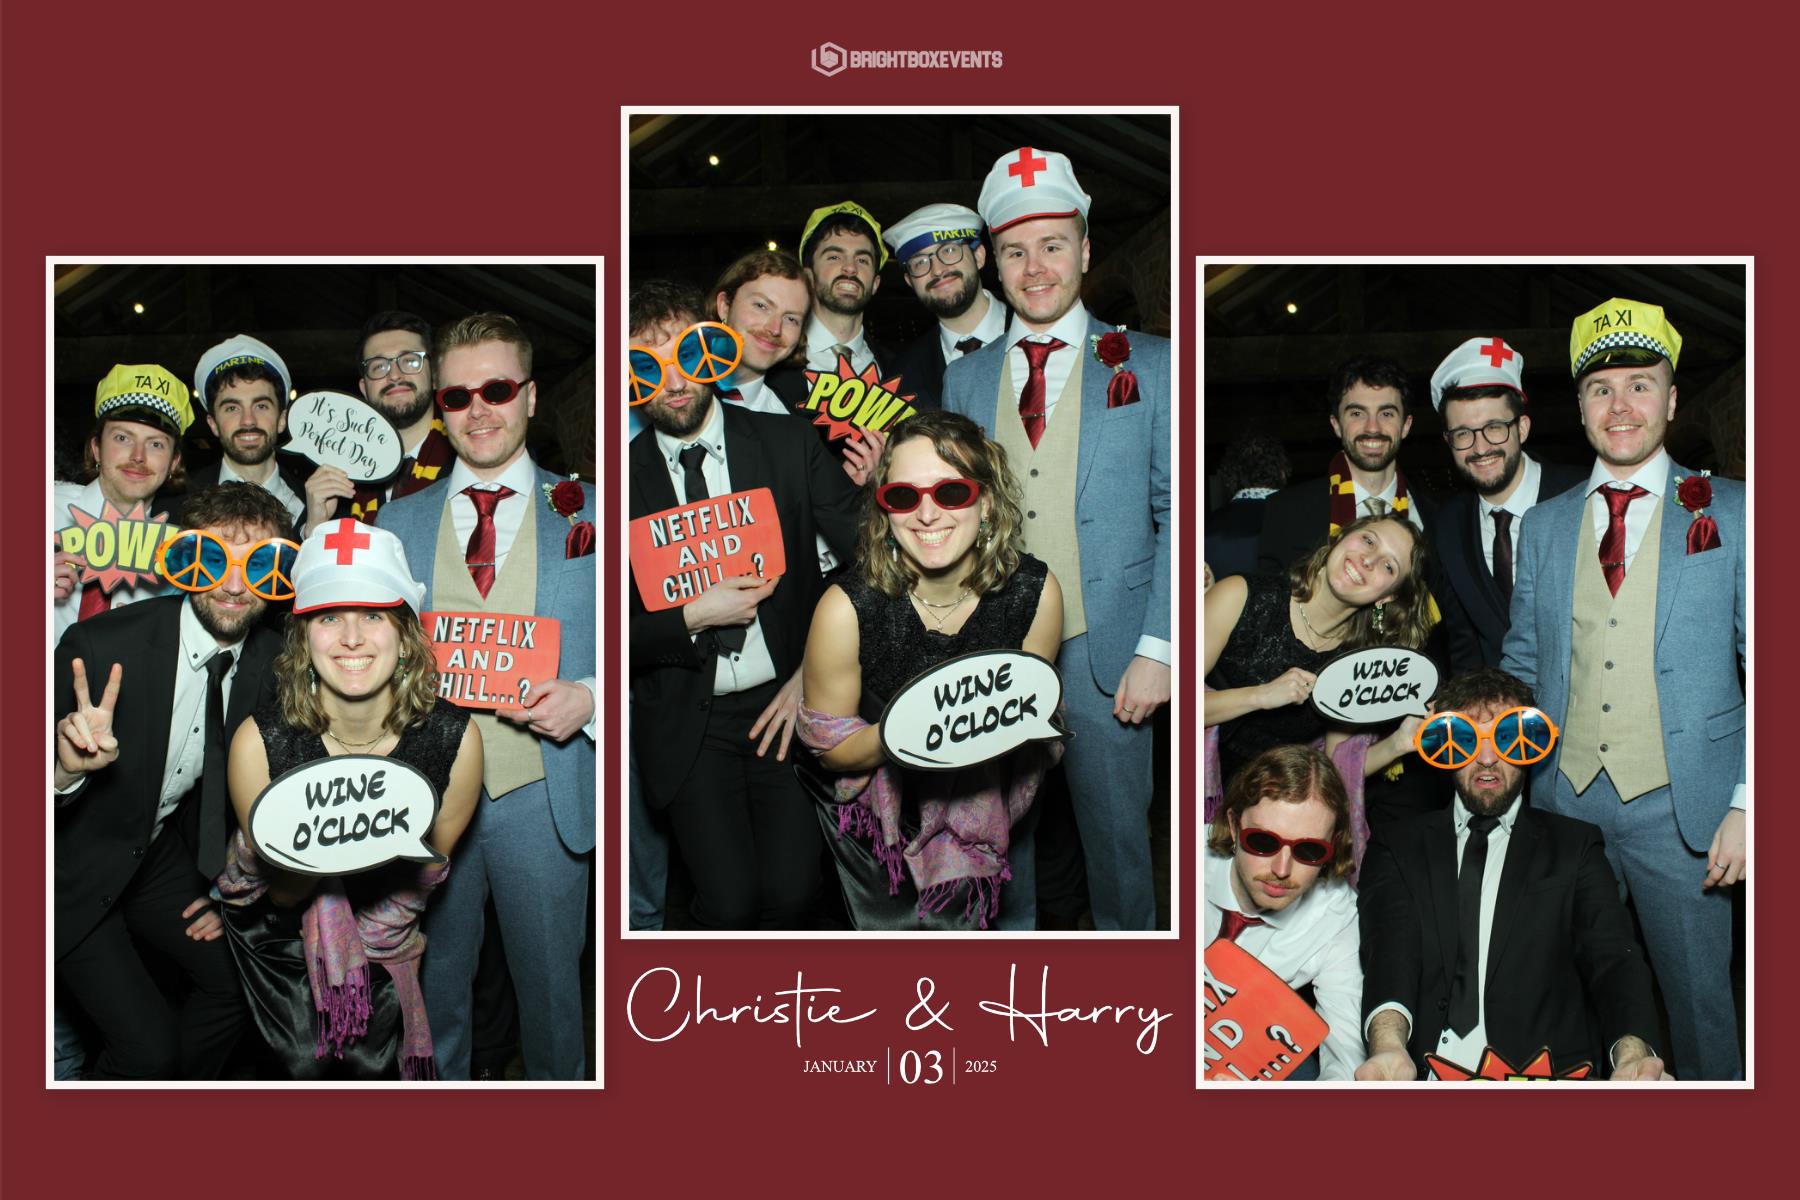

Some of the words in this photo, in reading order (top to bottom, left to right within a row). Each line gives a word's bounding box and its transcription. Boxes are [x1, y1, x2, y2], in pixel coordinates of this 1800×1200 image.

[215, 355, 265, 374] MARINE
[310, 396, 336, 423] It's
[336, 407, 377, 442] Such
[377, 433, 388, 445] a
[299, 421, 347, 455] Perfect
[349, 441, 378, 478] Day
[648, 495, 755, 548] NETFLIX
[678, 534, 742, 569] AND
[433, 615, 537, 649] NETFLIX
[447, 648, 514, 673] AND
[1353, 657, 1411, 681] WINE
[431, 671, 531, 705] HILL...?
[934, 662, 1013, 712] WINE
[1338, 682, 1421, 708] O'CLOCK
[926, 693, 1038, 751] O'CLOCK
[305, 770, 386, 810] WINE
[292, 806, 410, 851] O'CLOCK
